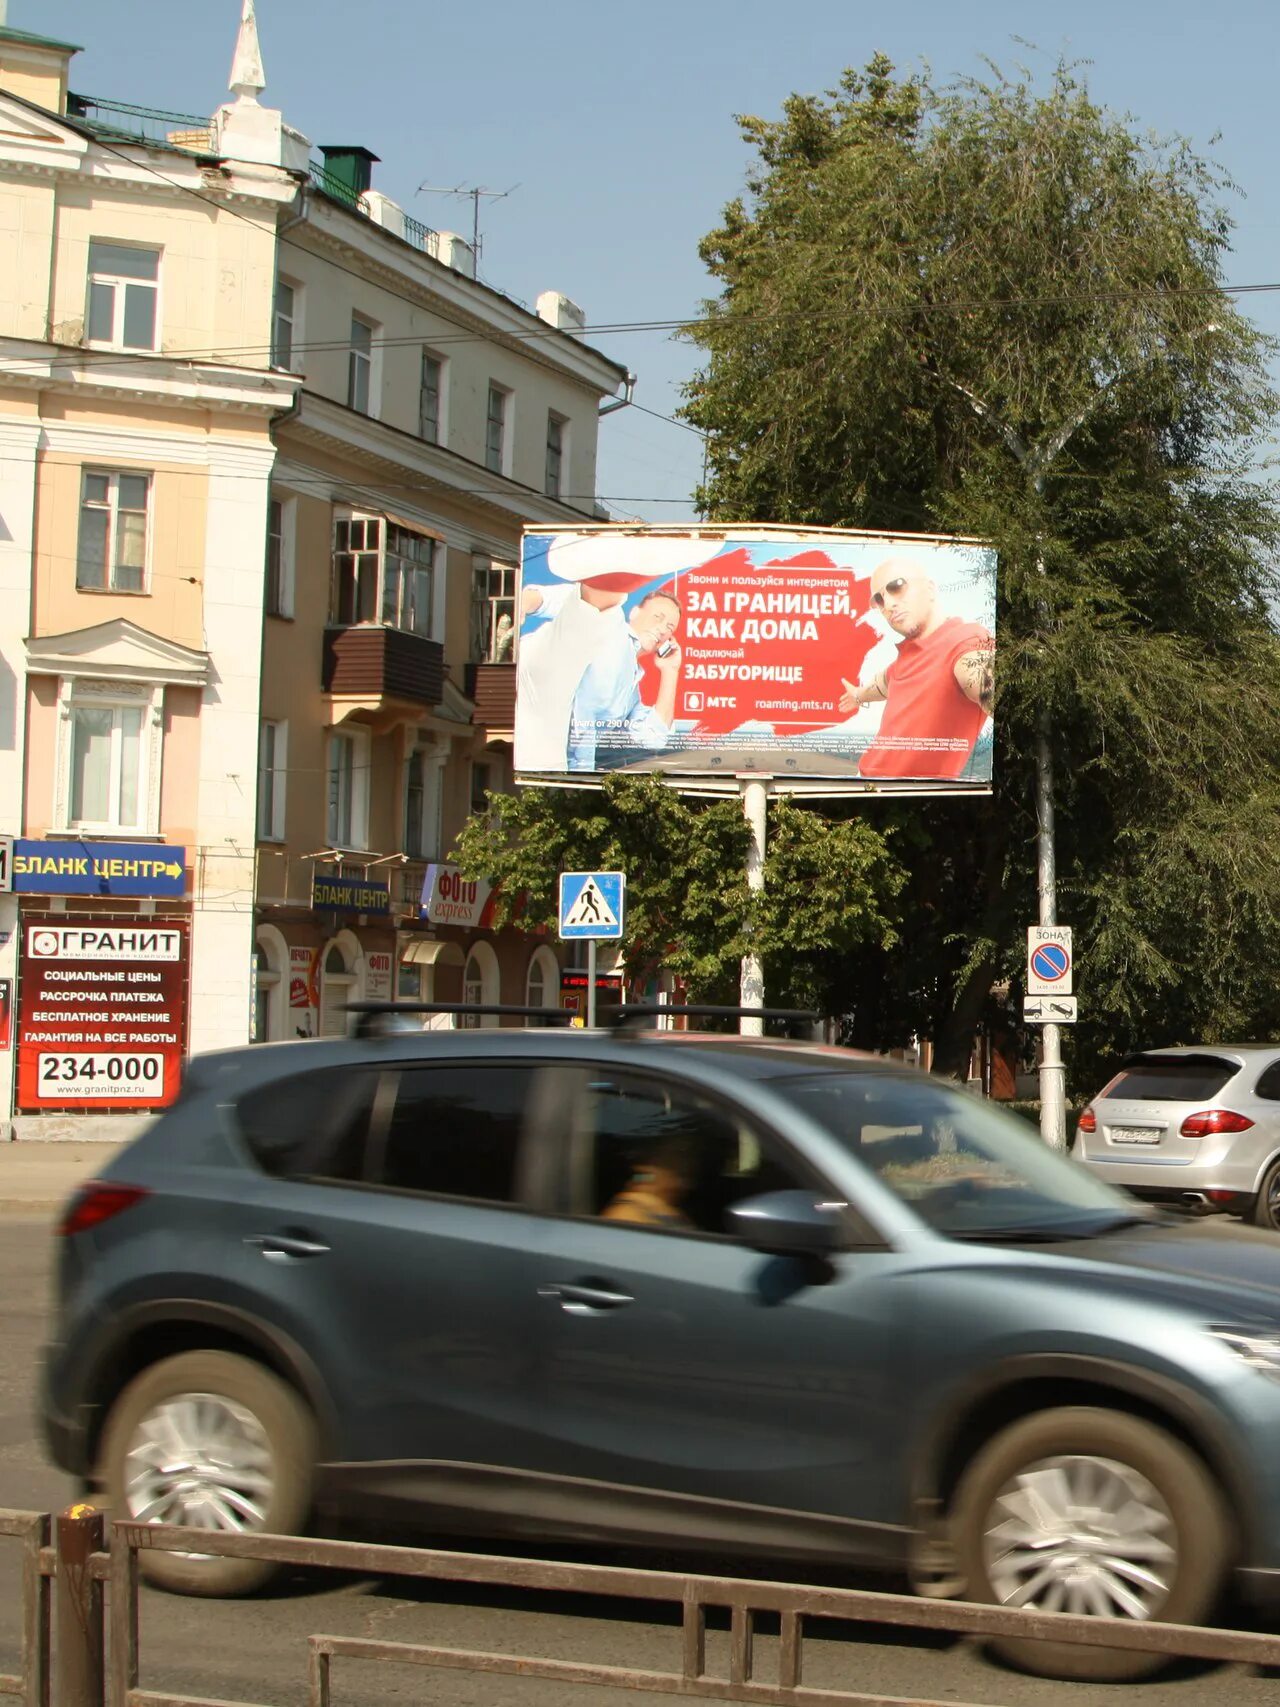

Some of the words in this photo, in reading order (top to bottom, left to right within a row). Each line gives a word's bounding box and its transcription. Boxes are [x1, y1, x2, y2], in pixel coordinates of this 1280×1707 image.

[687, 573, 720, 584] Звони
[721, 576, 729, 584] и
[731, 576, 784, 587] пользуйся
[787, 577, 849, 589] интернетом
[687, 591, 717, 612] ЗА
[723, 589, 857, 619] ГРАНИЦЕЙ,
[686, 617, 735, 639] КАК
[740, 618, 818, 644] ДОМА
[685, 647, 744, 660] Подключай
[684, 664, 803, 684] ЗАБУГОРИЩЕ
[707, 697, 737, 708] МТС
[755, 699, 834, 711] roaming.mts.ru
[606, 719, 622, 728] 290
[13, 856, 88, 875] БЛАНК
[93, 858, 166, 879] ЦЕНТР
[315, 885, 351, 905] БЛАНК
[354, 888, 388, 909] ЦЕНТР
[434, 902, 472, 922] express
[62, 932, 177, 951] ГРАНИТ
[1036, 931, 1064, 940] ЗОНА
[44, 971, 125, 982] СОЦИАЛЬНЫЕ
[128, 973, 161, 982] ЦЕНЫ
[40, 992, 108, 1001] РАССРОЧКА
[110, 993, 164, 1002] ПЛАТЕЖА
[32, 1012, 108, 1022] БЕСПЛАТНОЕ
[111, 1013, 170, 1022] ХРАНЕНИЕ
[25, 1033, 83, 1042] ГАРАНТИЯ
[86, 1033, 101, 1042] НА
[104, 1033, 126, 1042] ВСЕ
[130, 1033, 176, 1043] РАБОТЫ
[43, 1057, 159, 1080] 234-000
[57, 1085, 145, 1095] www.granitpnz.ru
